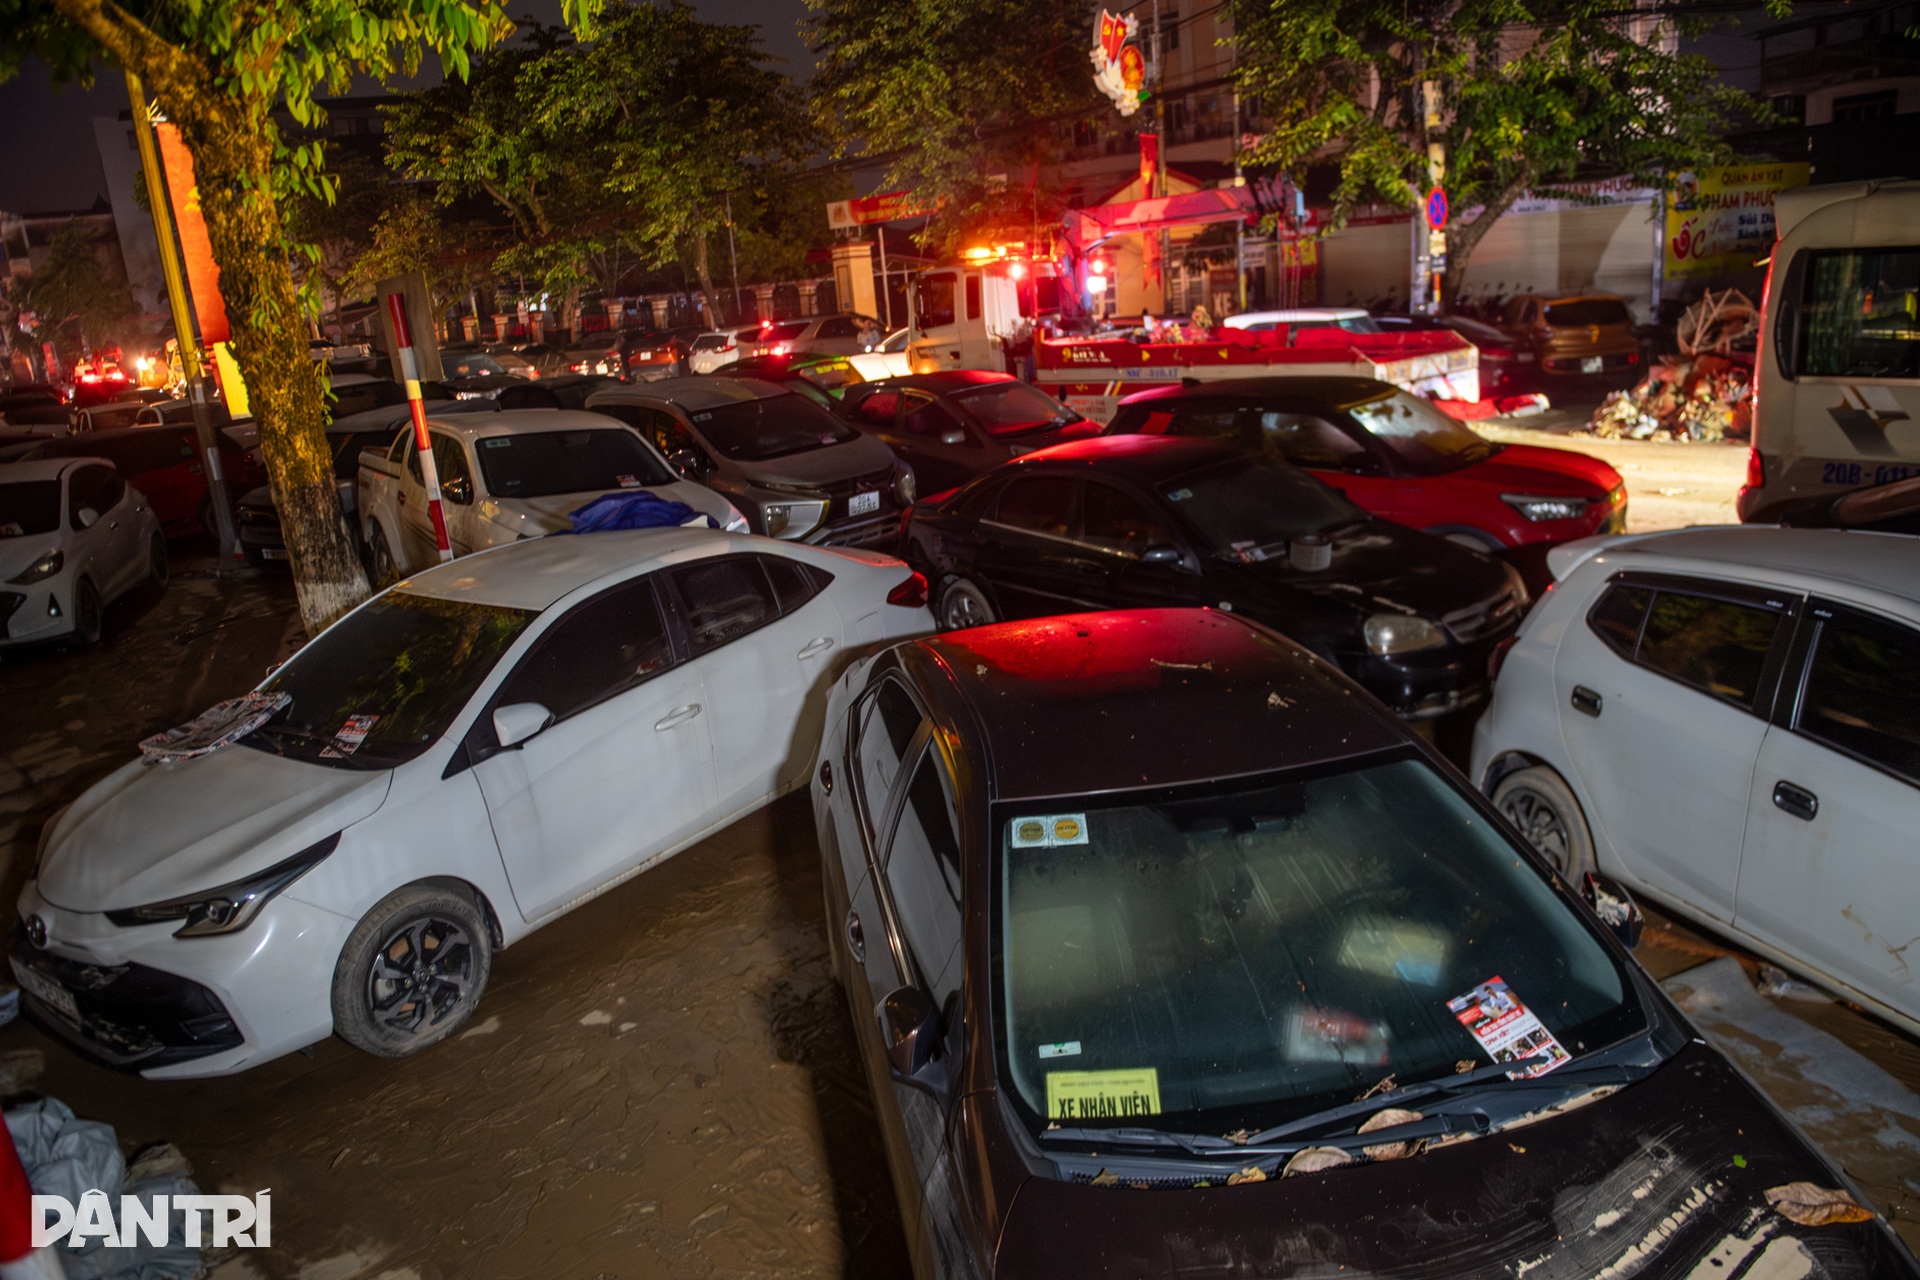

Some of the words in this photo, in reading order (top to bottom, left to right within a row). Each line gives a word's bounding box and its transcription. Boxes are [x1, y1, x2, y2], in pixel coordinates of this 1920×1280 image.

[1058, 1098, 1075, 1119] XE
[1079, 1092, 1116, 1119] NHÂN
[1120, 1090, 1152, 1116] VIÊN
